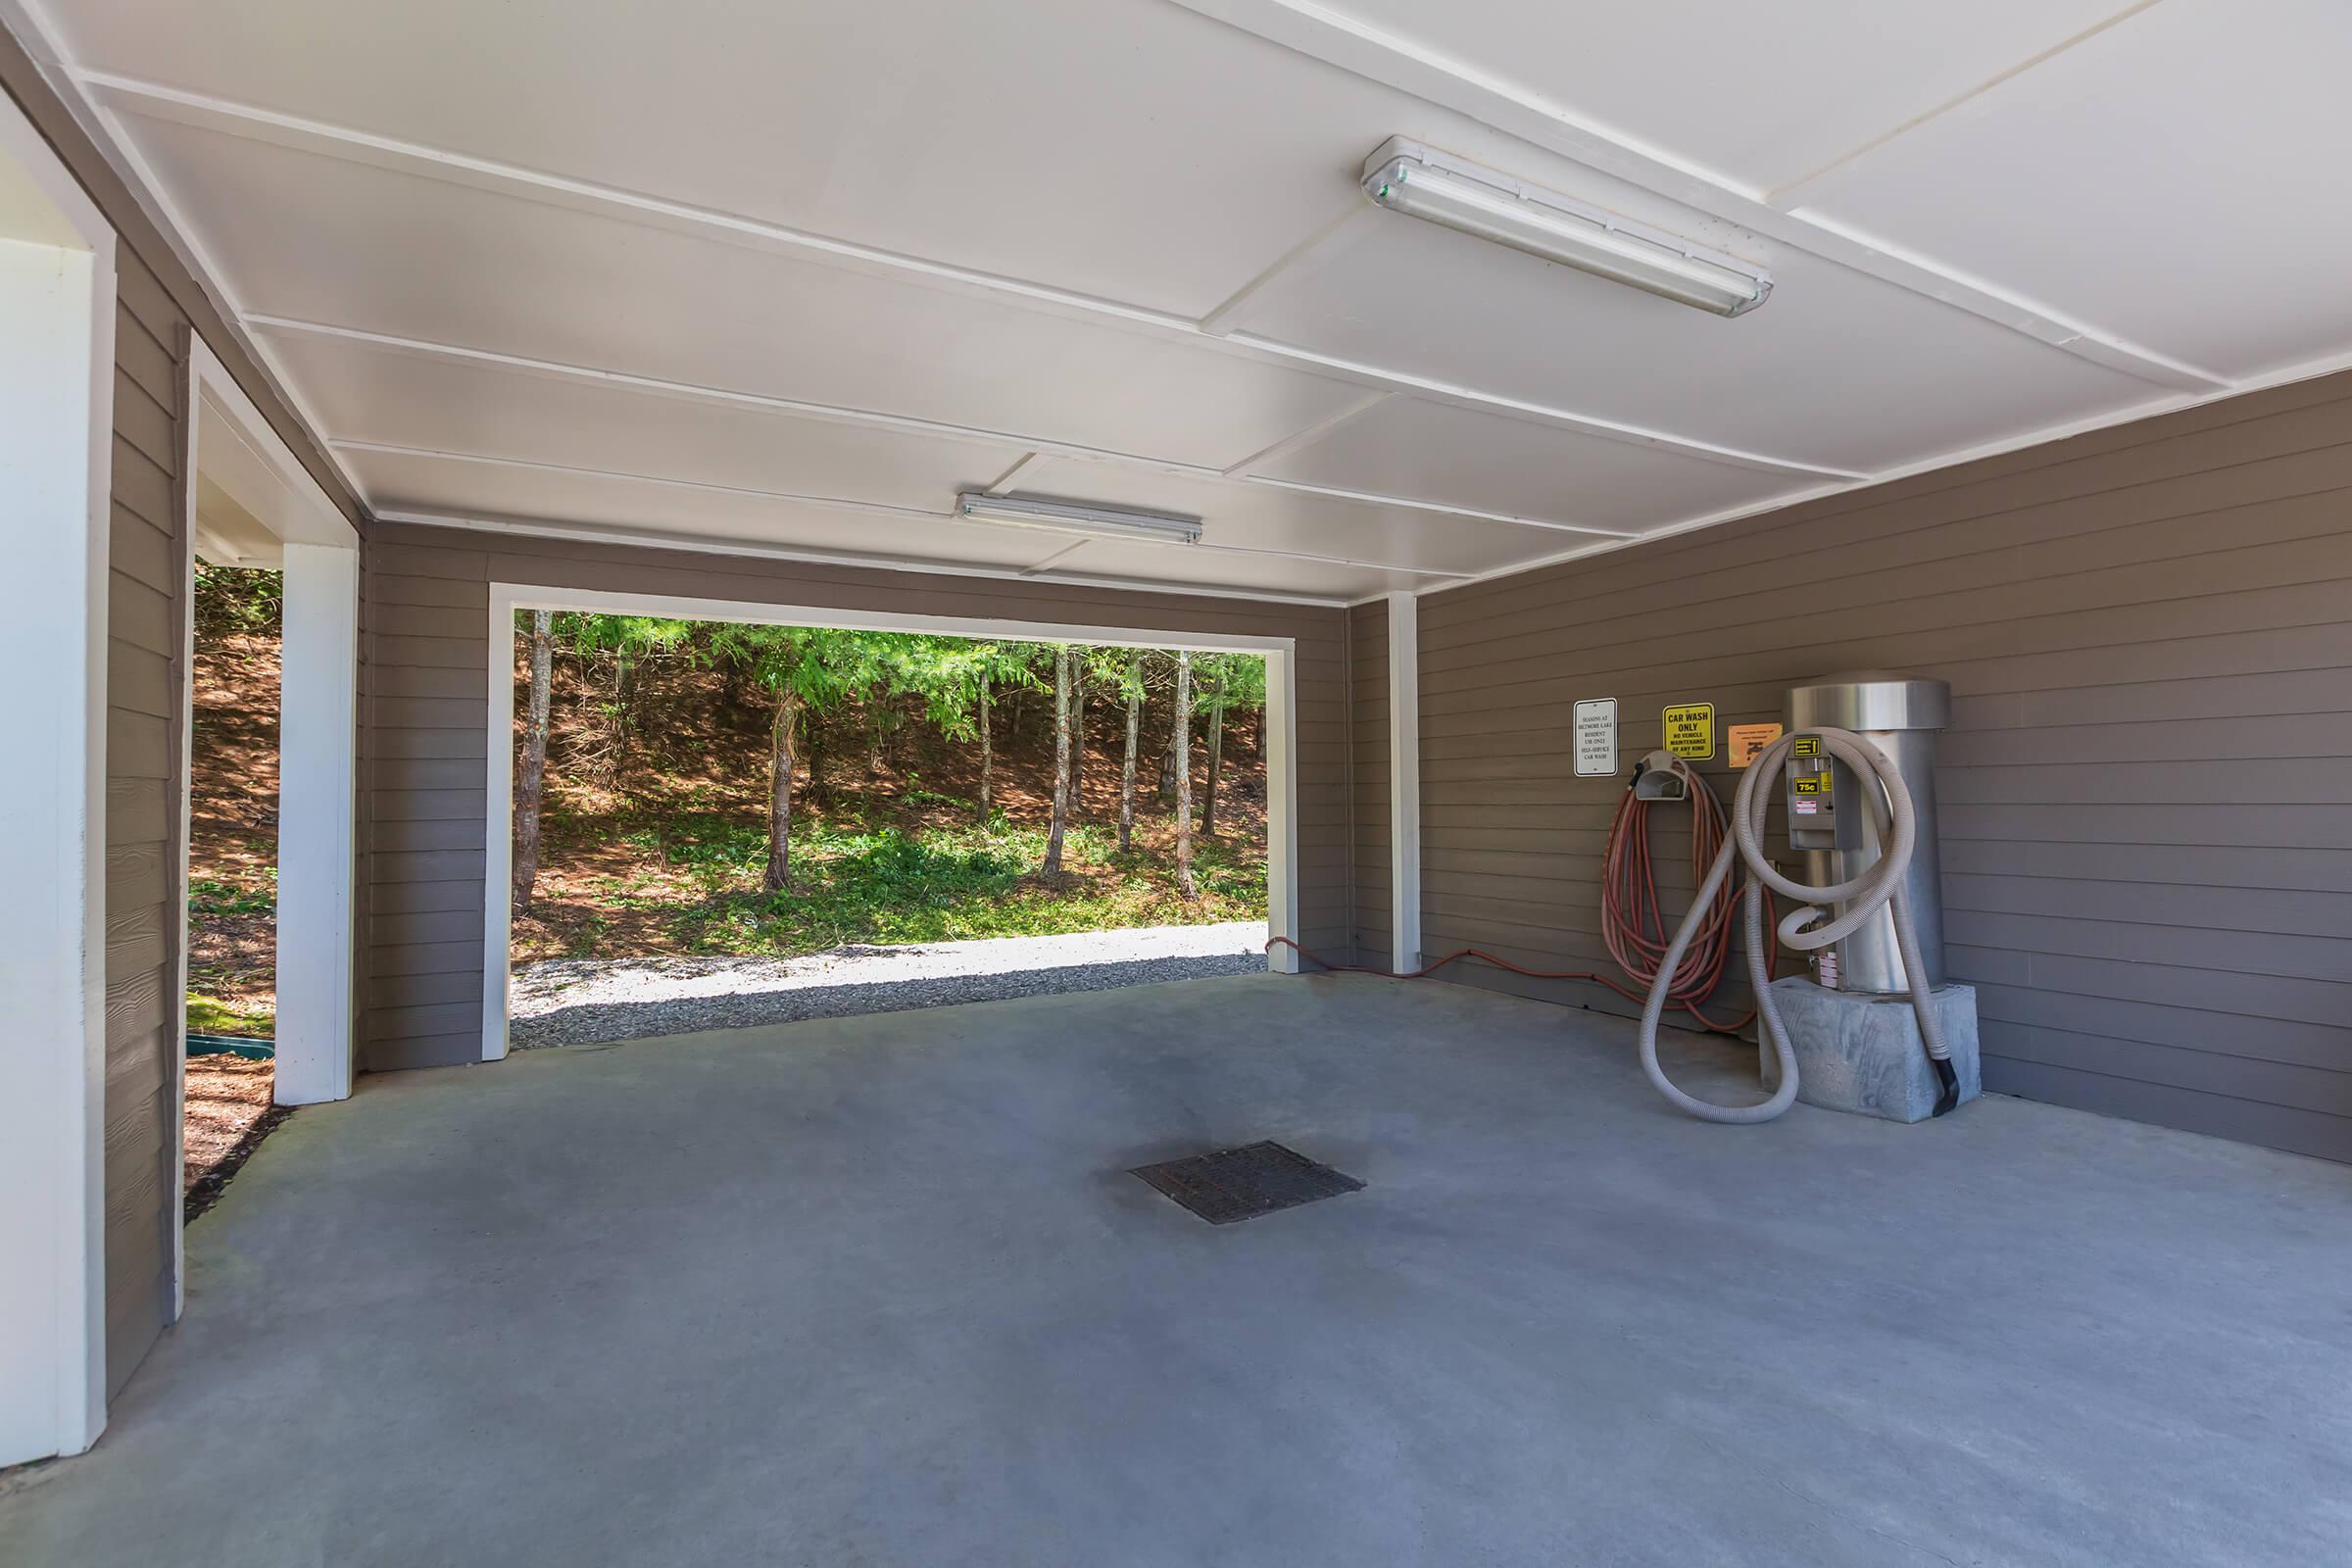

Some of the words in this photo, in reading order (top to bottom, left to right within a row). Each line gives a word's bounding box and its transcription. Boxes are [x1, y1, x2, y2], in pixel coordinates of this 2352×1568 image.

[1668, 714, 1683, 722] CAR
[1686, 712, 1708, 721] WASH
[1678, 723, 1697, 732] ONLY
